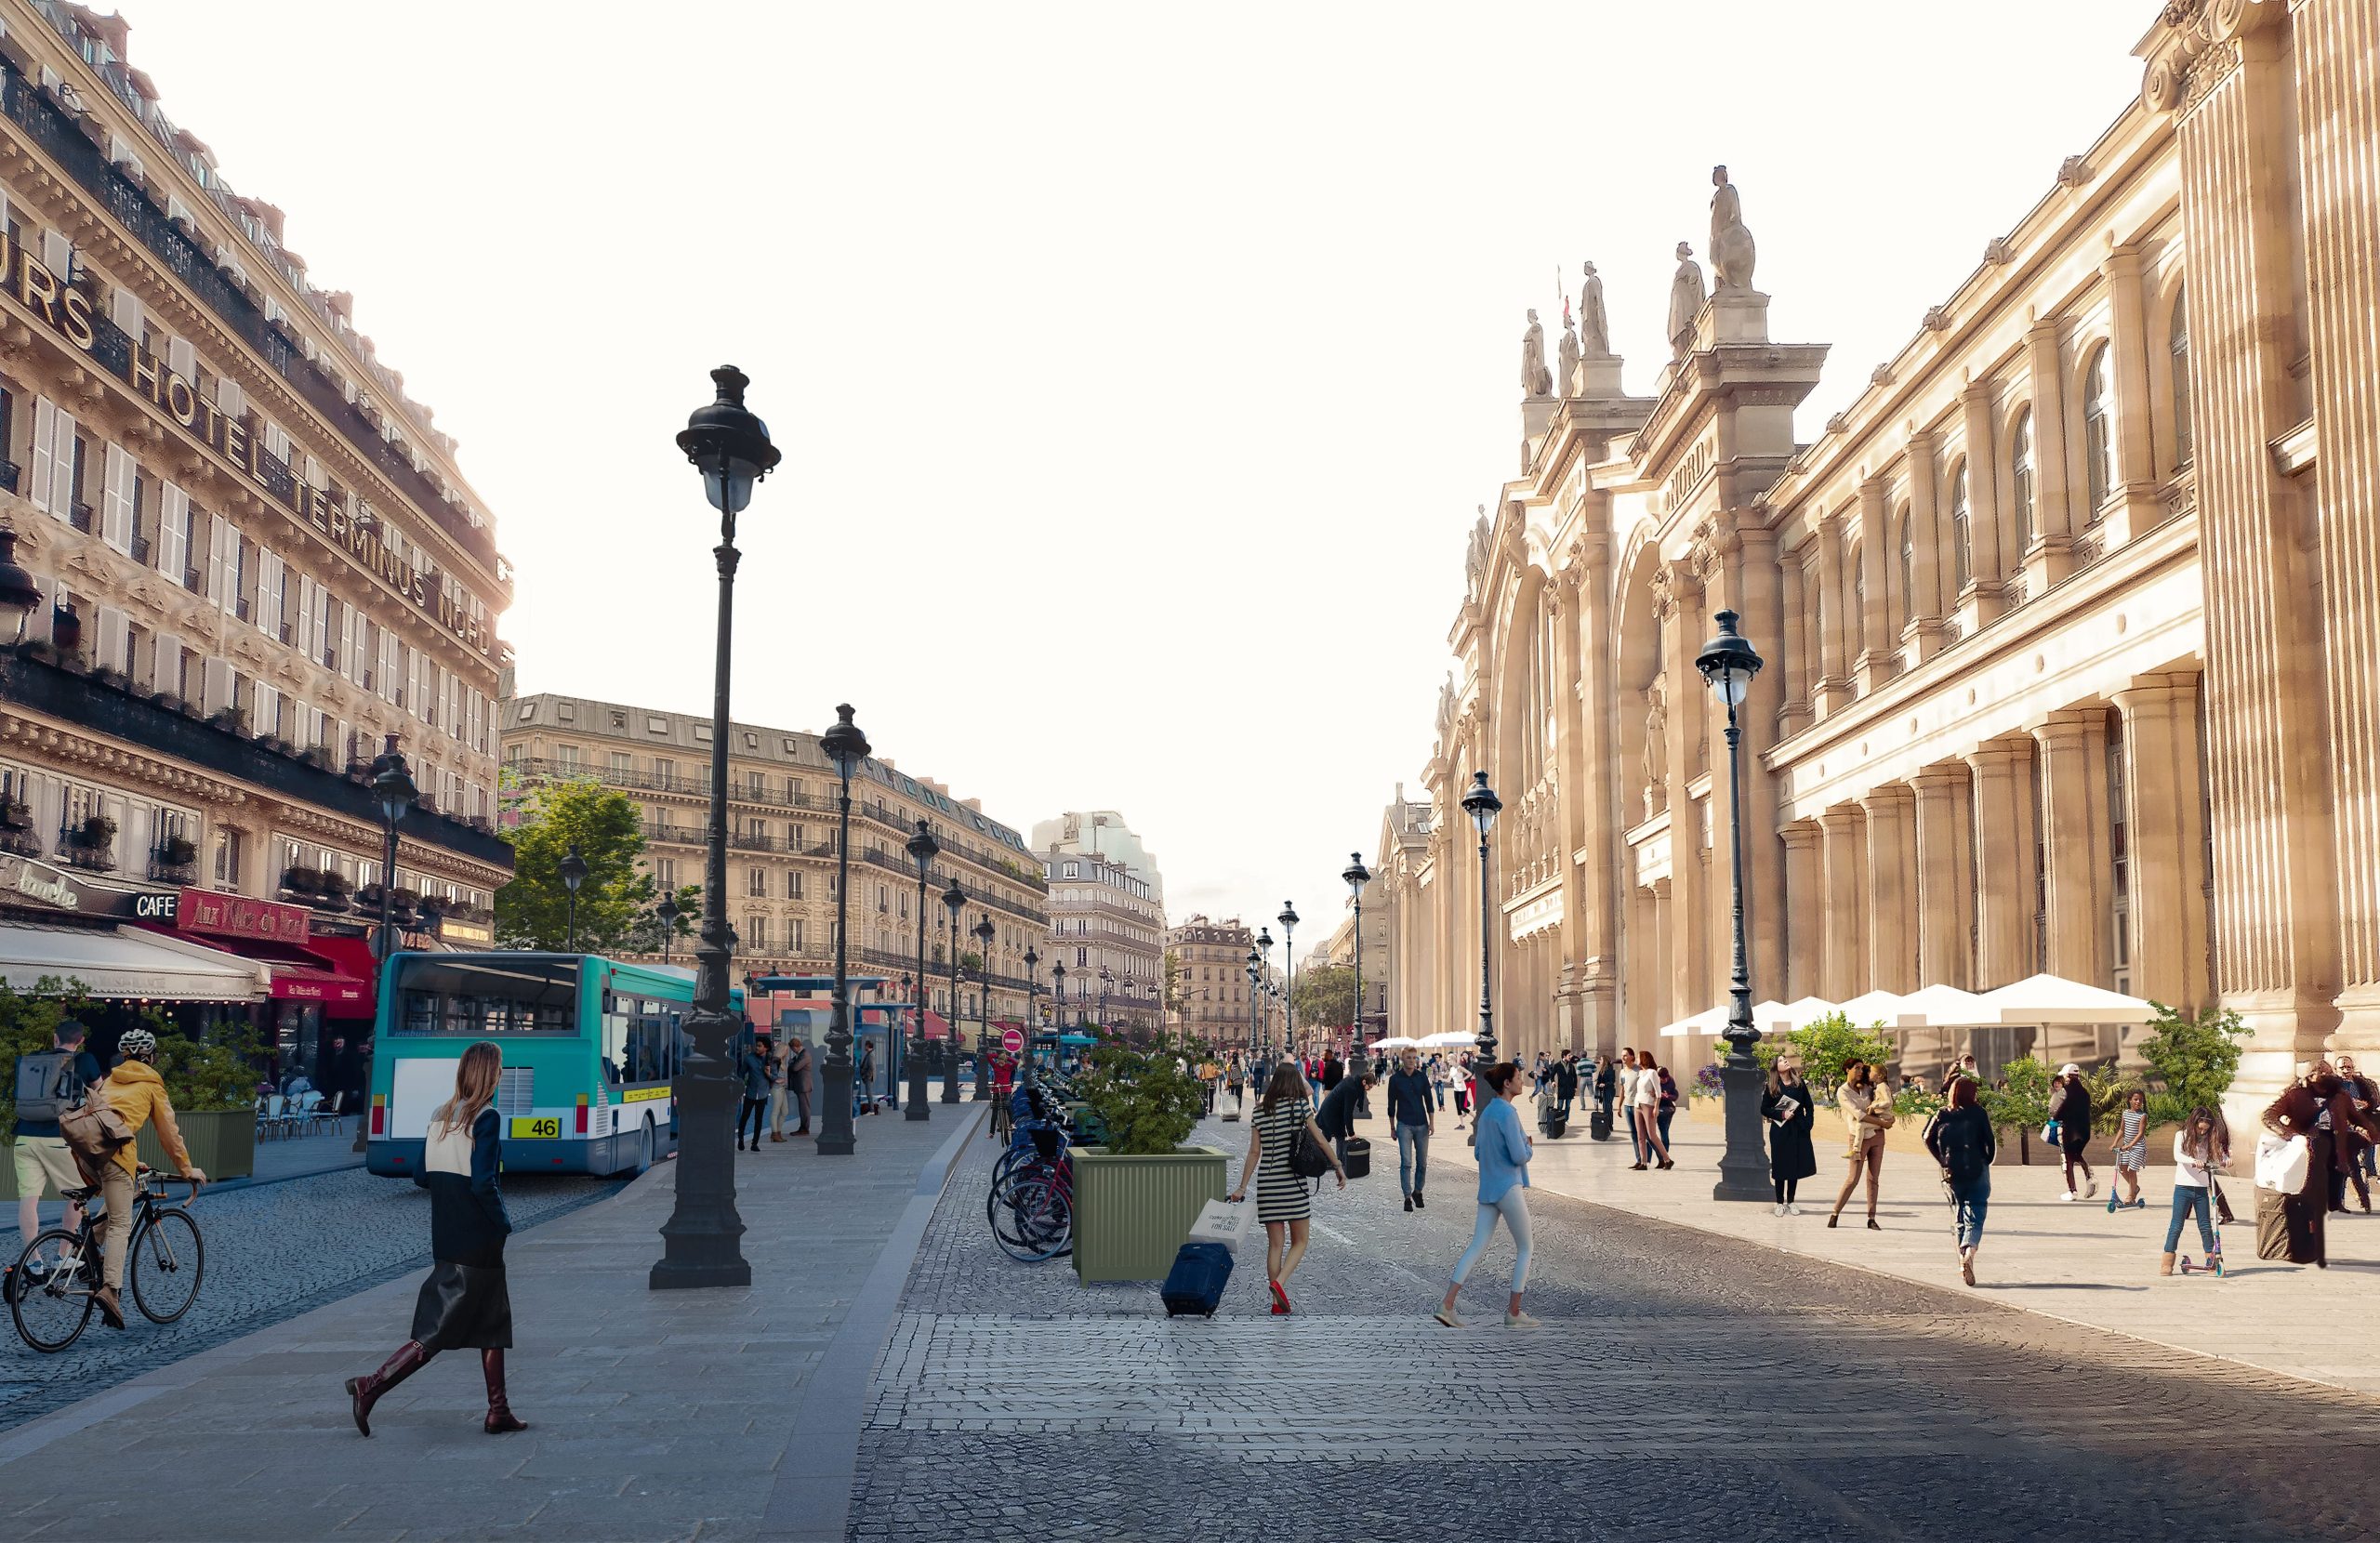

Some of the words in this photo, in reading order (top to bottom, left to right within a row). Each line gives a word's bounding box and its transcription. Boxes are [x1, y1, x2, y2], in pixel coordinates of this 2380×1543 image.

[132, 341, 268, 487] HOTEL
[290, 468, 426, 608] TERMINUS
[137, 895, 175, 917] CAFE
[532, 1119, 556, 1136] 46
